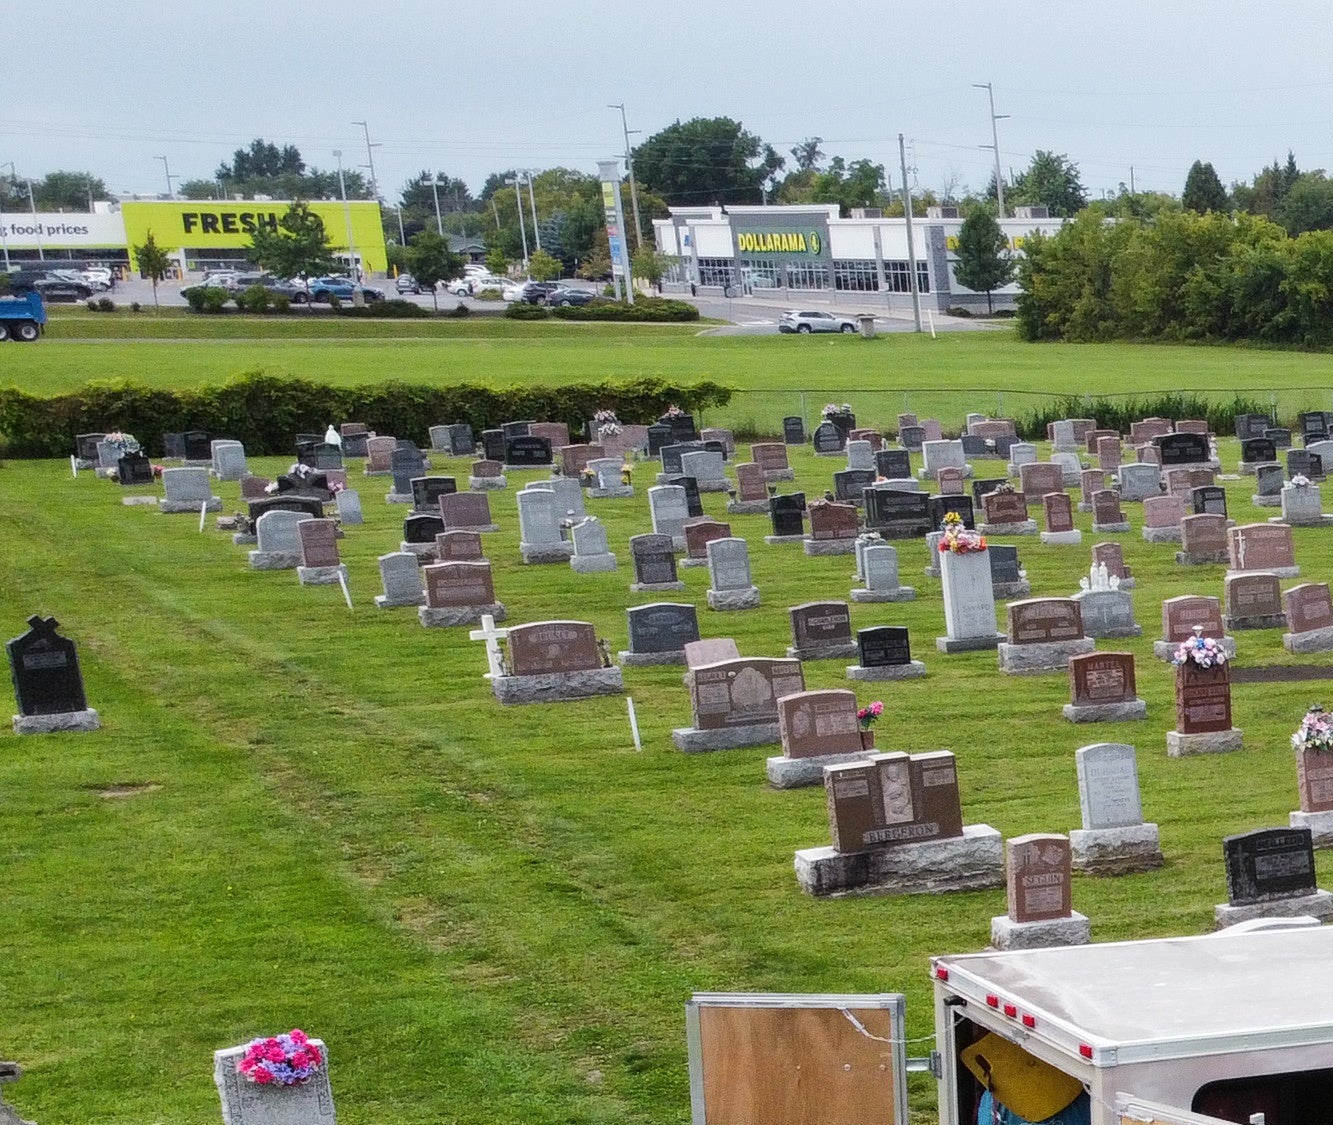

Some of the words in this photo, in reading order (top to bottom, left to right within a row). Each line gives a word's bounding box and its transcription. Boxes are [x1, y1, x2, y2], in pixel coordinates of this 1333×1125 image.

[11, 224, 43, 235] food
[47, 223, 89, 237] prices
[738, 232, 806, 253] DOLLARAMA
[869, 824, 934, 842] BERGERON
